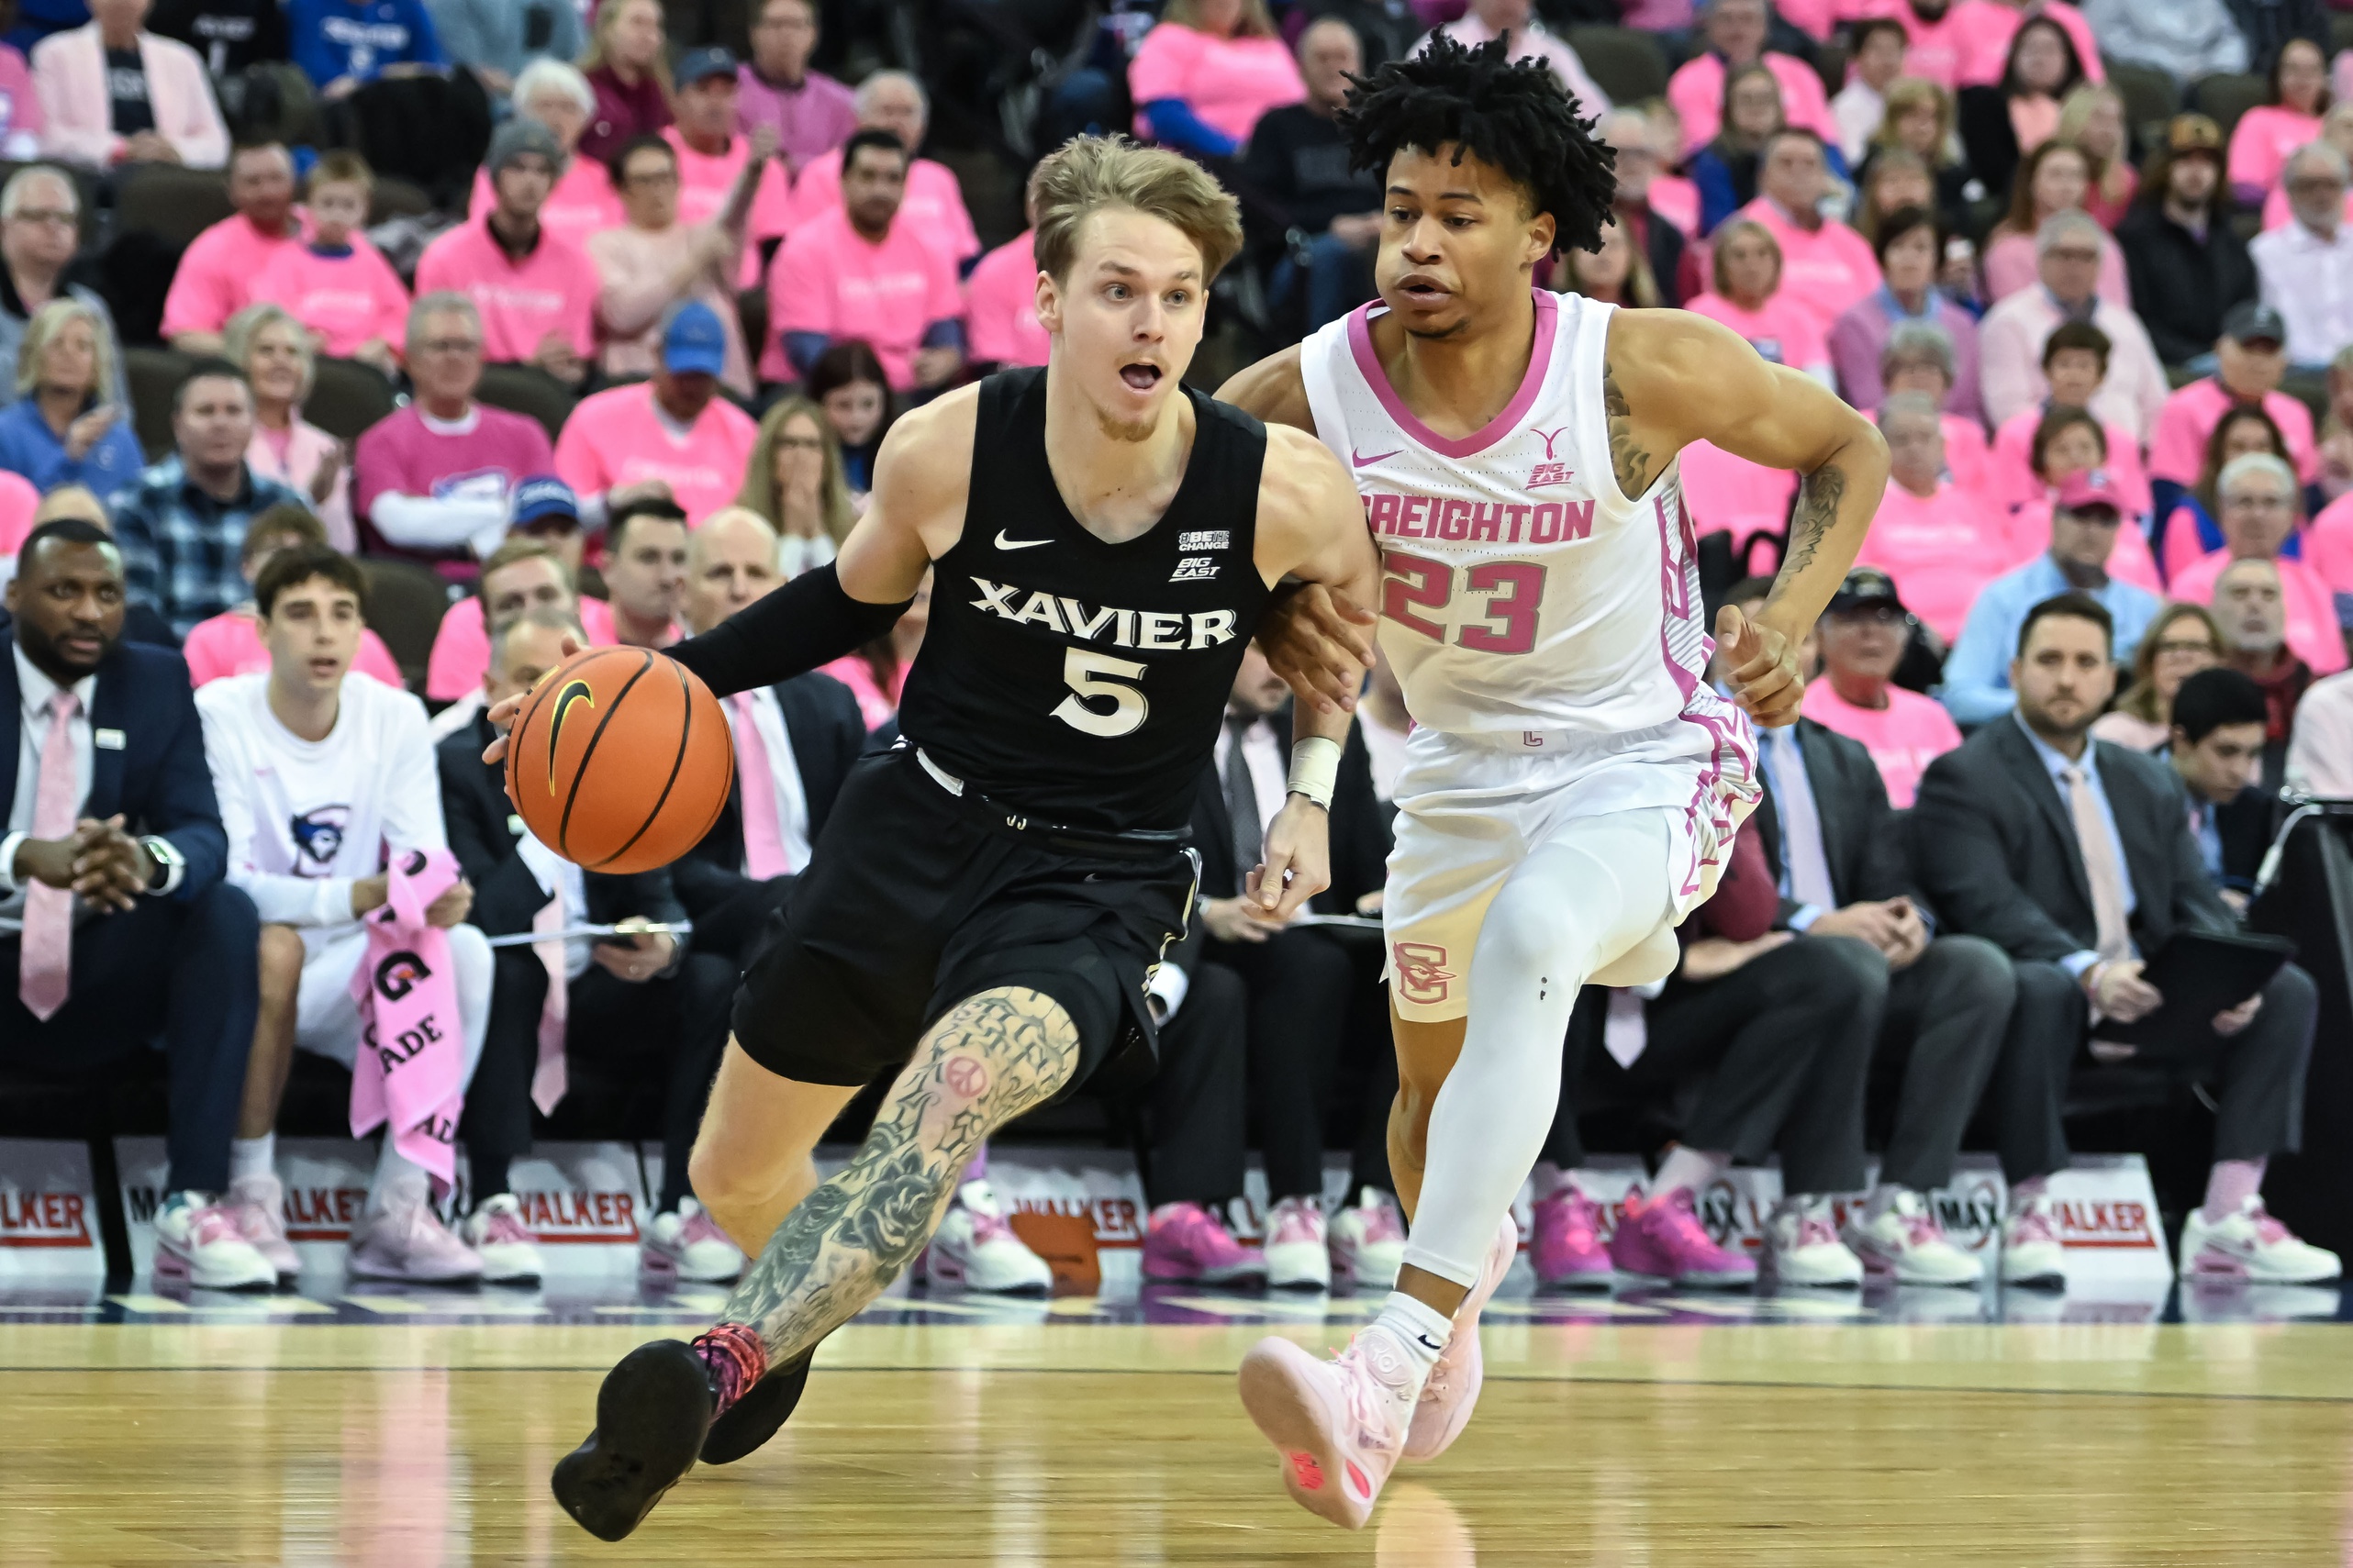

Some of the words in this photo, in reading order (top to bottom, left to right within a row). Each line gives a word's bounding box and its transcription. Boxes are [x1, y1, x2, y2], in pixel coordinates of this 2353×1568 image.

[1528, 471, 1575, 484] EAST
[1532, 462, 1566, 474] BIG
[1361, 494, 1595, 544] REIGHTON
[1177, 557, 1212, 569] BIG
[1178, 541, 1230, 551] CHANGE
[1172, 566, 1221, 578] EAST
[969, 576, 1238, 651] XAVIER
[1379, 547, 1548, 655] 23
[1049, 646, 1149, 737] 5
[379, 1013, 443, 1074] ADE
[0, 1193, 85, 1229] LKER
